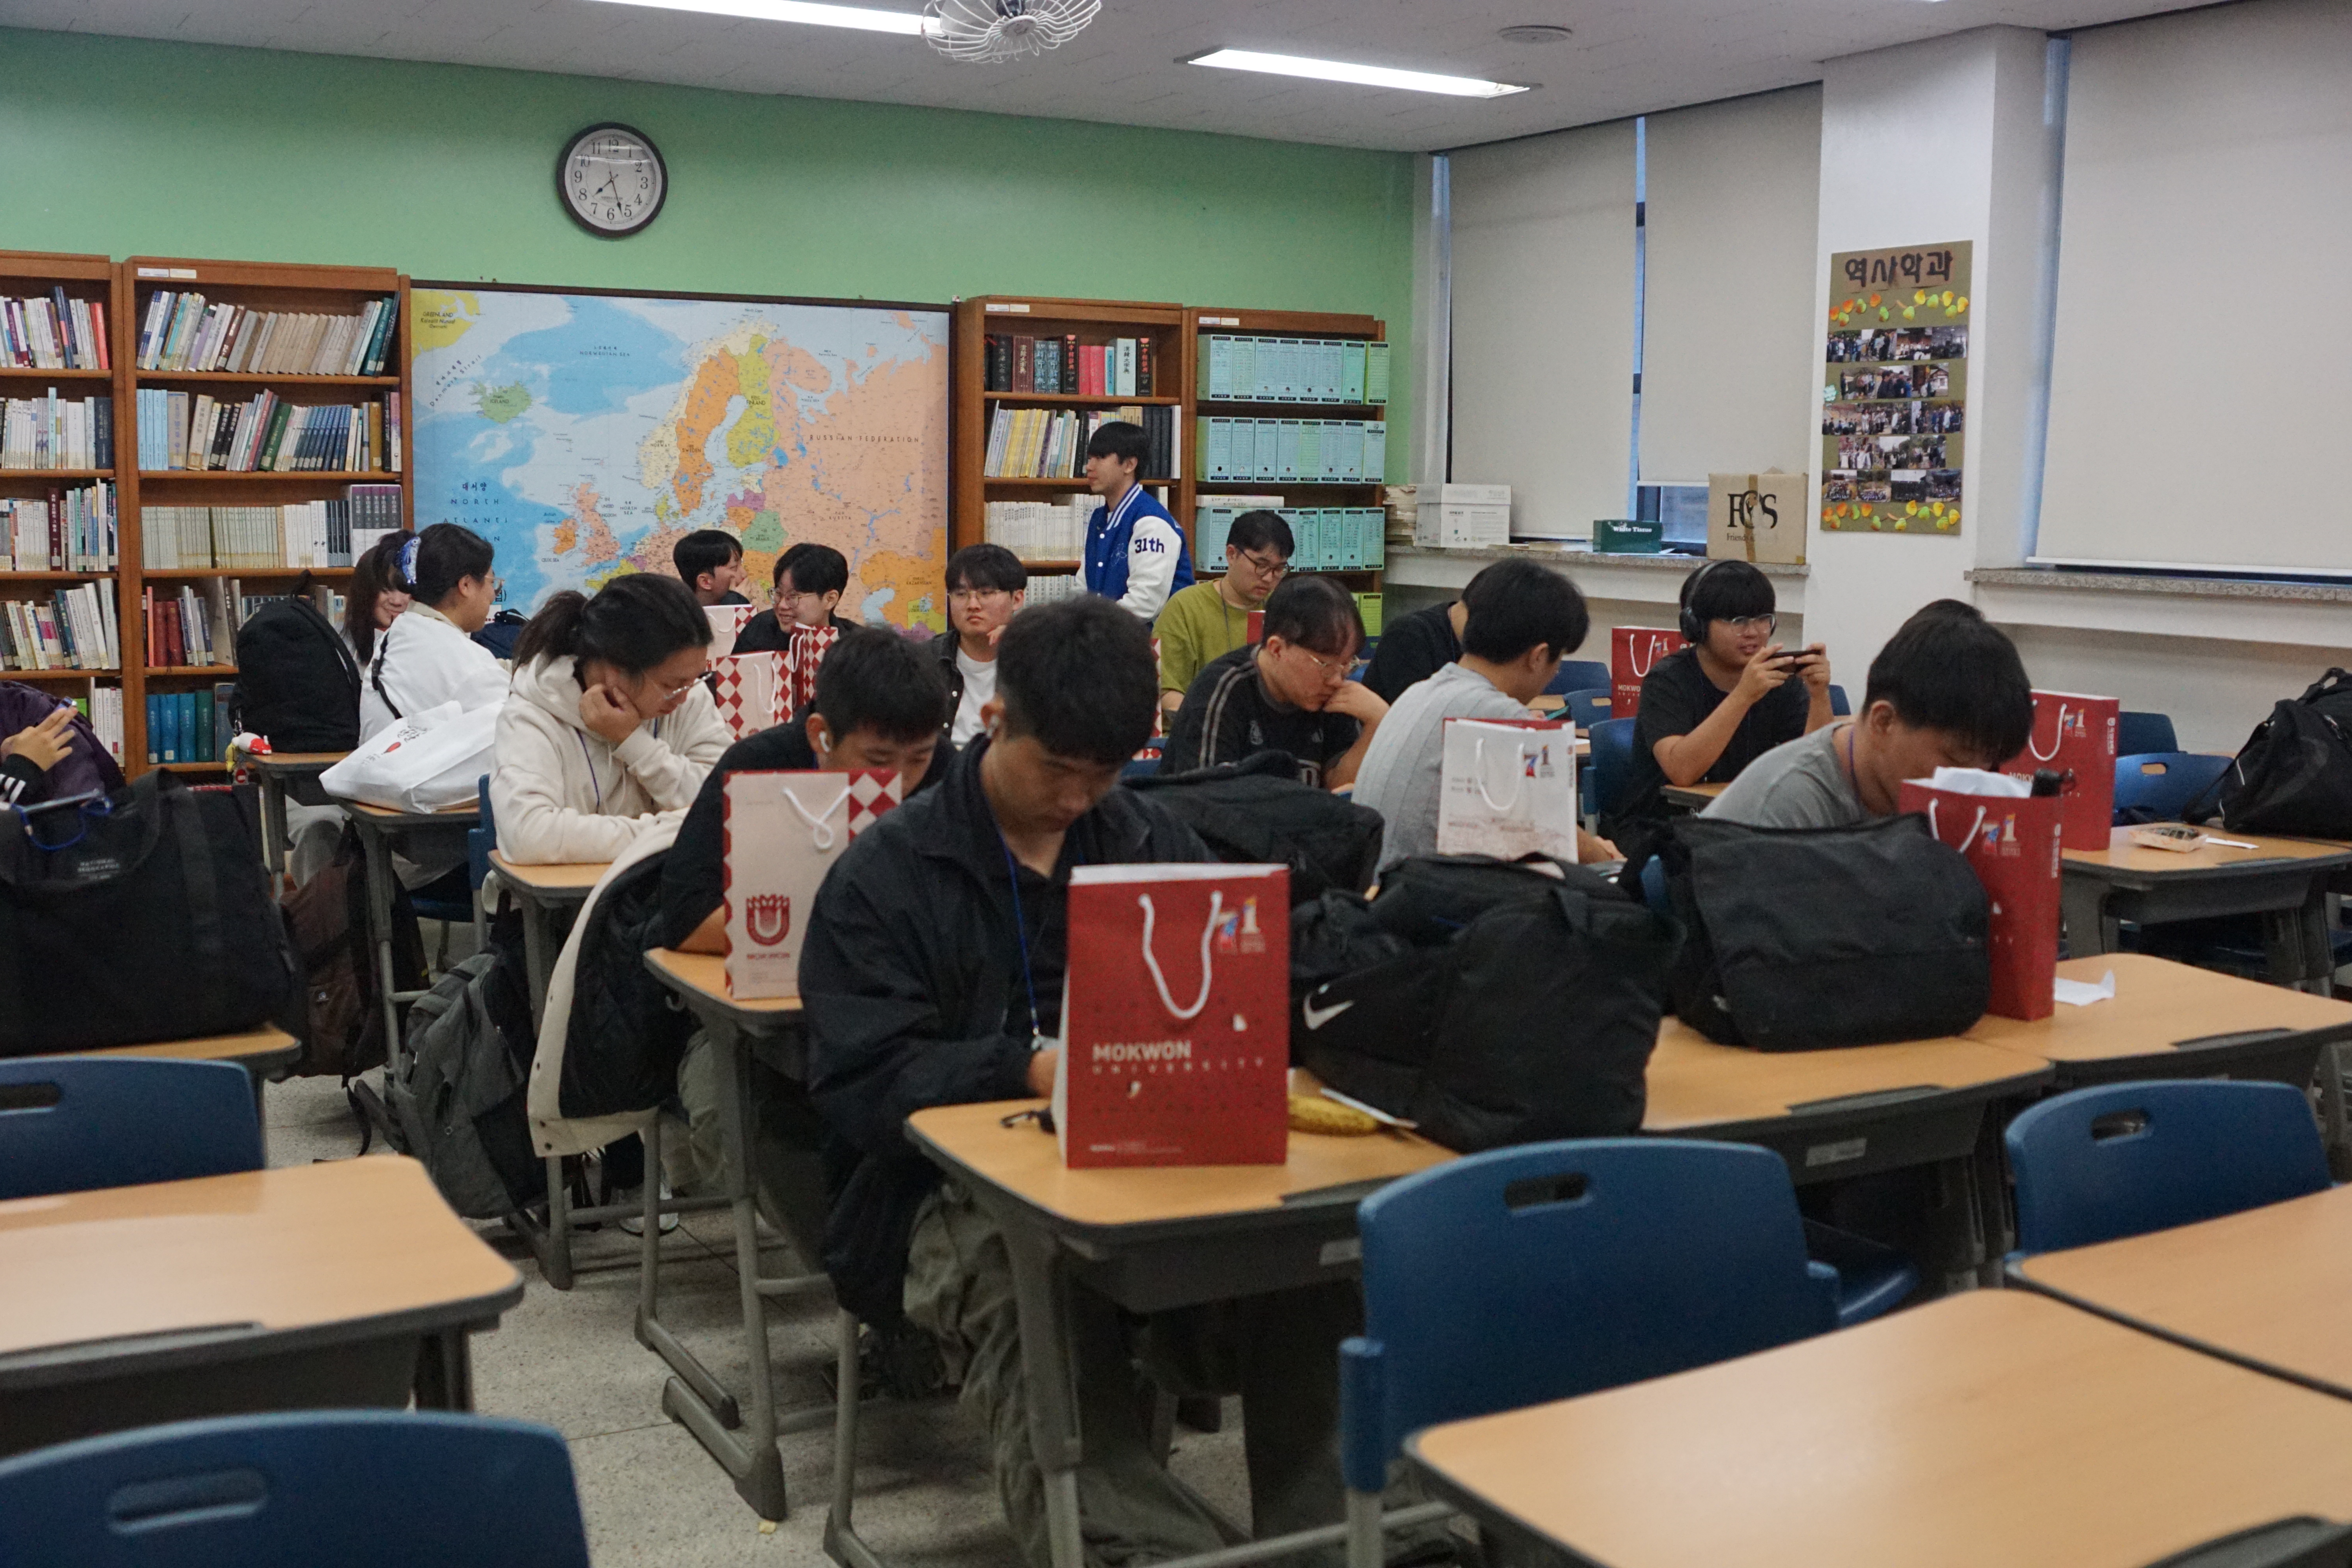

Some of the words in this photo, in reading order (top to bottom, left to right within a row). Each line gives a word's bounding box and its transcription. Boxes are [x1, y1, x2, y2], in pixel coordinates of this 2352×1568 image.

[592, 142, 601, 154] 11
[608, 139, 619, 153] 12
[580, 154, 590, 167] 10
[635, 160, 642, 172] 2
[574, 171, 583, 183] 9
[640, 177, 648, 189] 3
[579, 188, 587, 201] 8
[634, 194, 642, 205] 4
[590, 203, 598, 214] 7
[606, 208, 615, 220] 6
[624, 205, 632, 217] 5
[462, 482, 487, 492] 대서양
[1134, 537, 1165, 554] 31th
[1617, 684, 1641, 693] MOKWO
[1092, 1040, 1192, 1062] MOKWON
